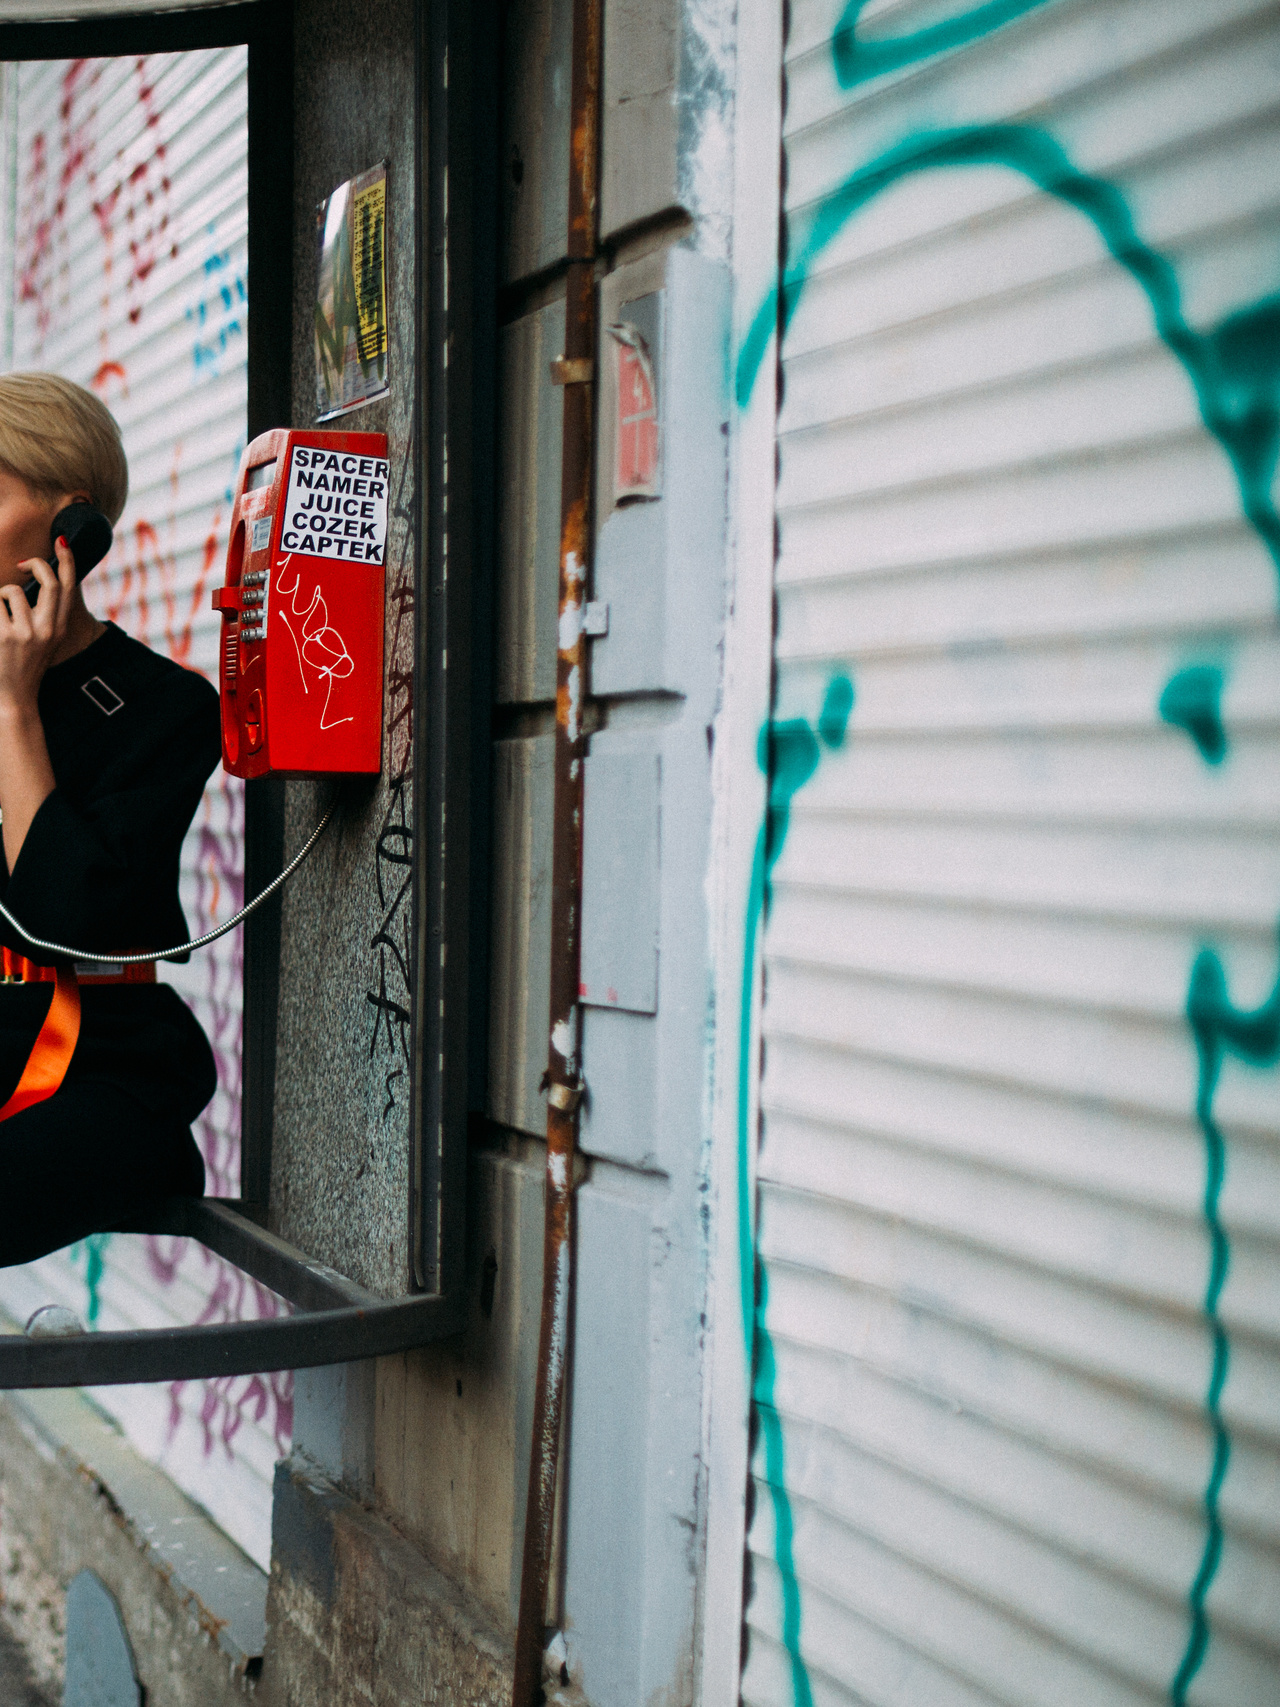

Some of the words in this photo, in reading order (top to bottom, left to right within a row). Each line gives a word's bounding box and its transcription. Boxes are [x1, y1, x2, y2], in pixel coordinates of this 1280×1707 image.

[294, 450, 388, 479] SPACER
[296, 470, 385, 499] NAMER
[300, 493, 375, 519] JUICE
[292, 512, 378, 540] COZEK
[283, 531, 383, 562] CAPTEK
